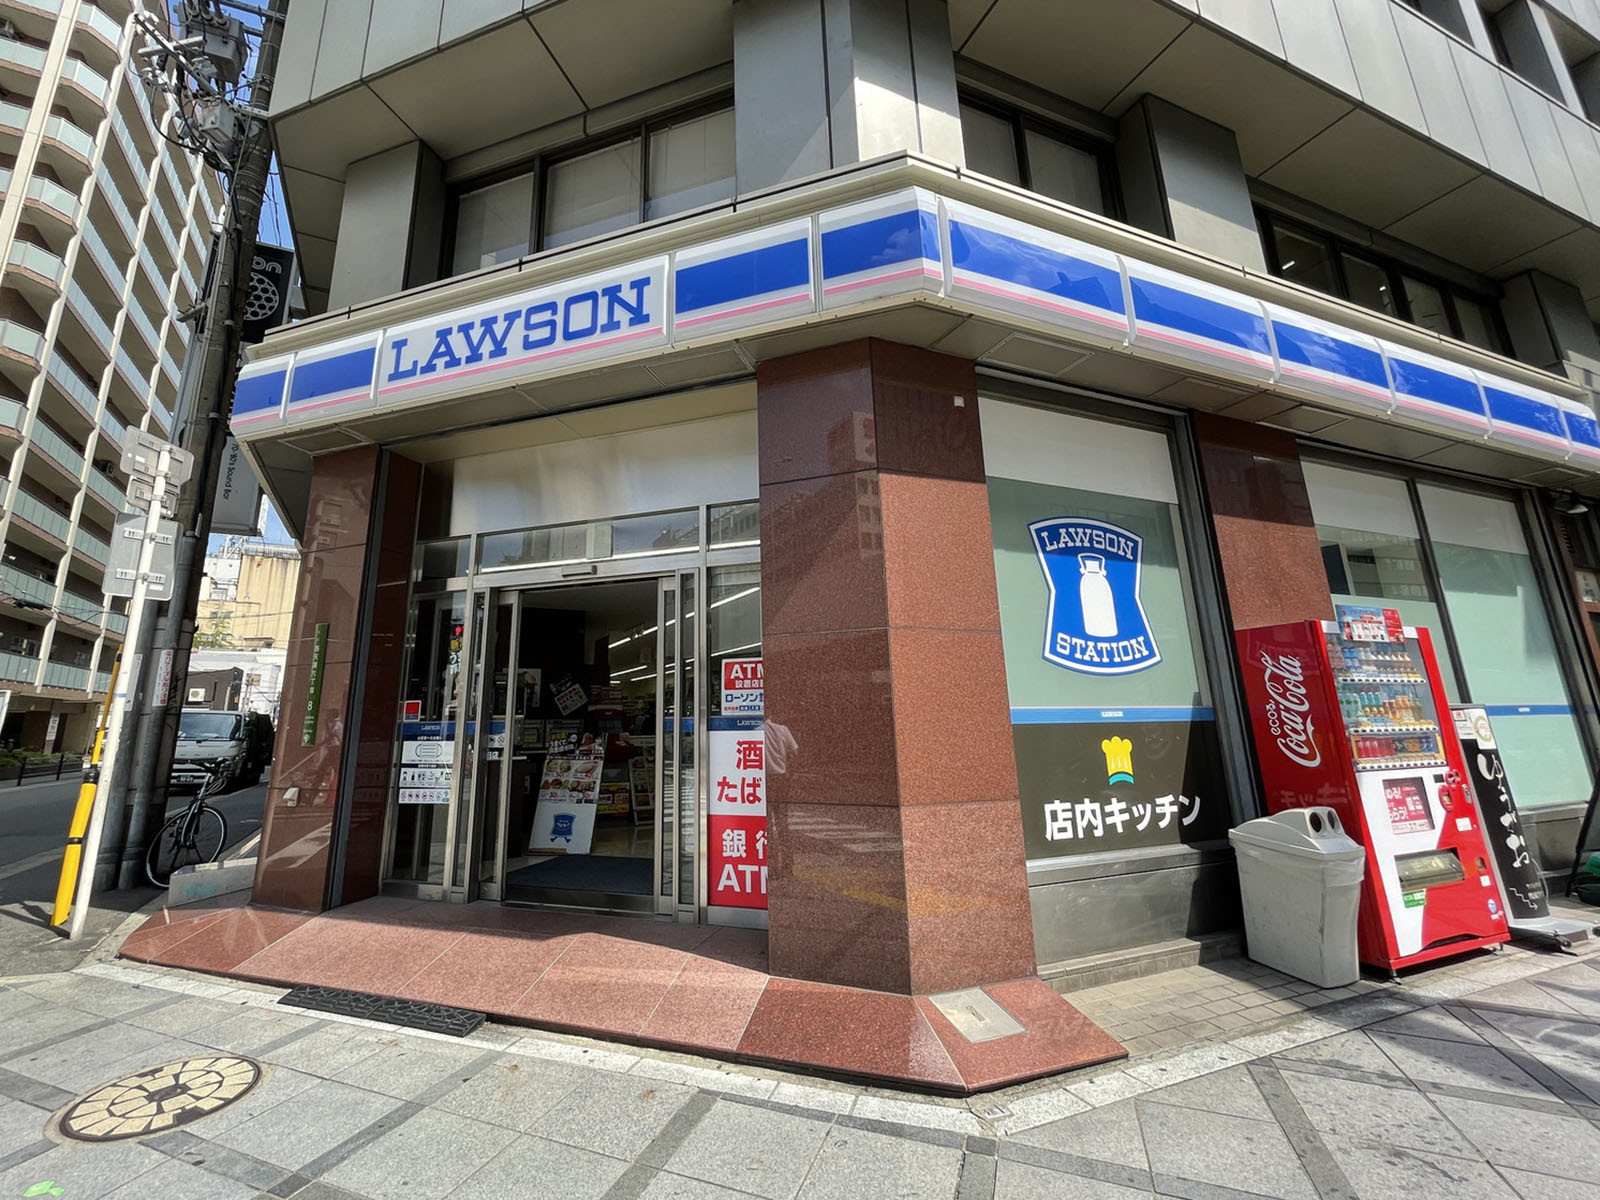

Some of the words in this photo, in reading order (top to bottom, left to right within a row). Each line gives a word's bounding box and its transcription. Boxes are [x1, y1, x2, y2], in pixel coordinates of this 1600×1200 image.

[387, 276, 651, 382] LAWSON
[224, 466, 236, 488] Sound
[223, 488, 232, 500] Bar
[1041, 527, 1134, 560] LAWSON
[1056, 632, 1150, 663] STATION
[1259, 650, 1321, 767] Coca-Cola
[736, 740, 764, 771] 酒
[717, 776, 762, 804] たば
[1044, 793, 1202, 842] 店内キッチン
